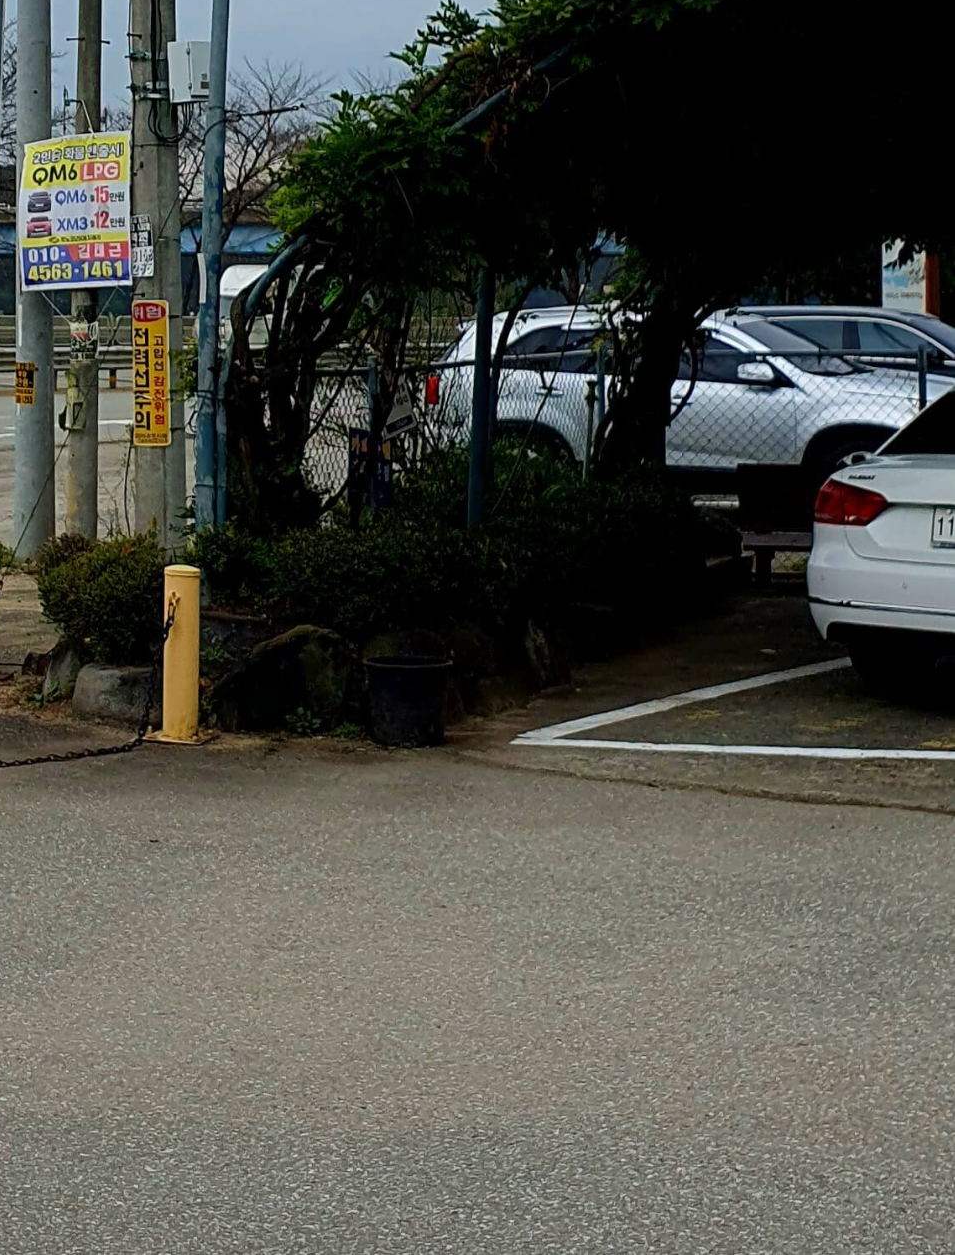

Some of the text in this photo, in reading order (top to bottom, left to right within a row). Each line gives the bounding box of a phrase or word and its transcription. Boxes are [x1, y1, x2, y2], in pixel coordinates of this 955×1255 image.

[32, 162, 119, 185] QM6 LPG
[55, 189, 87, 206] QM6
[56, 216, 88, 232] XM3
